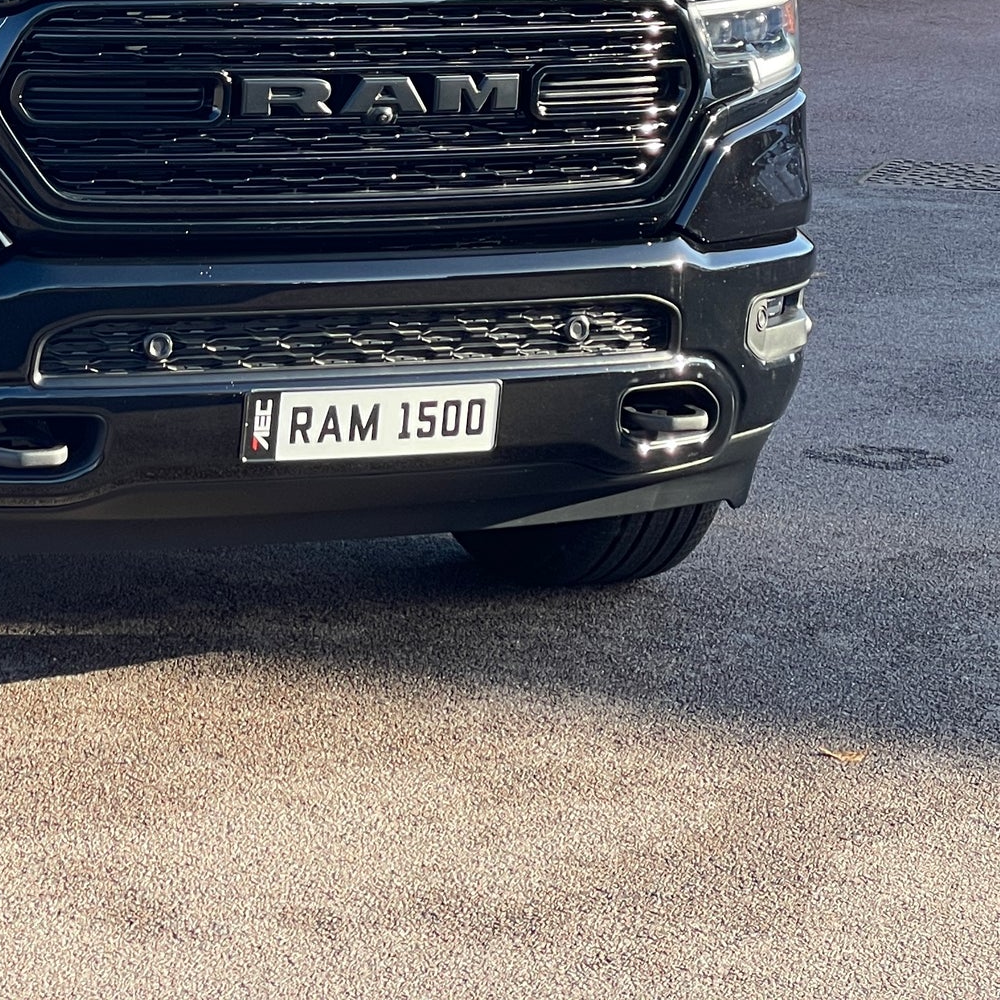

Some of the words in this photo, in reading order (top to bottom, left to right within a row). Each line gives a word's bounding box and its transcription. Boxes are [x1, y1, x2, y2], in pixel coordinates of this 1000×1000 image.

[241, 73, 521, 116] RAM
[289, 403, 381, 444] RAM
[398, 398, 487, 440] 1500
